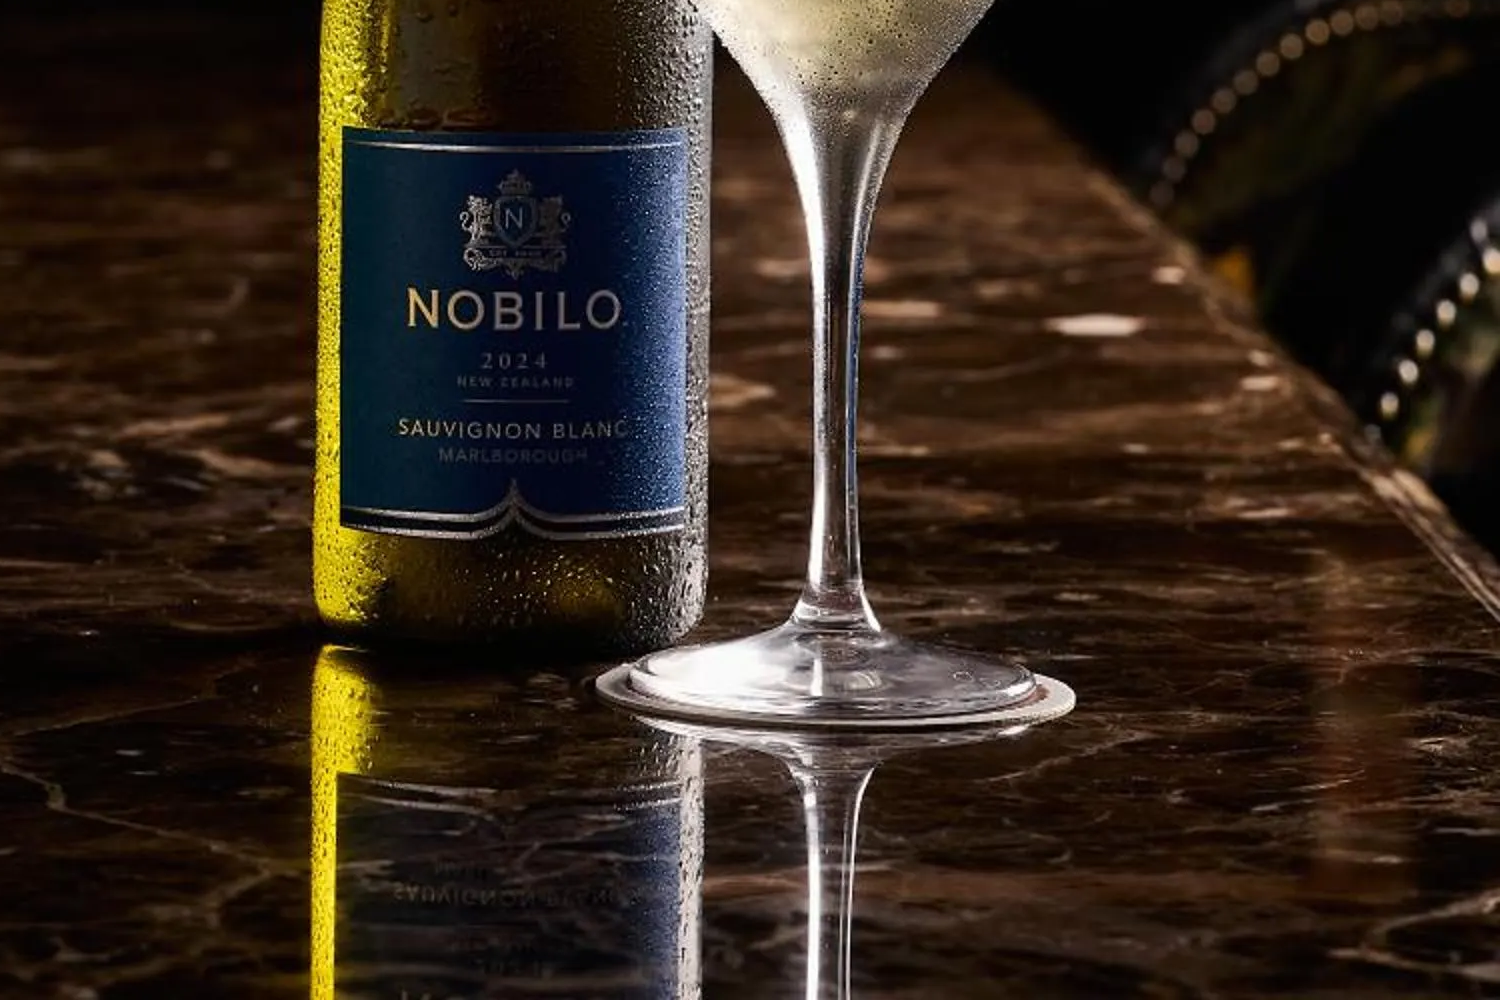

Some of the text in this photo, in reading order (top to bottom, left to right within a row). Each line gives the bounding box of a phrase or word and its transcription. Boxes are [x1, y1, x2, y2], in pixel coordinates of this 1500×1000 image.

[504, 206, 523, 230] N
[406, 285, 623, 332] NOBILO
[479, 351, 549, 370] 2024
[457, 374, 575, 389] NEW ZEALAND
[398, 416, 630, 440] SAUVIGNON BLANC
[438, 447, 589, 465] MARLBOROUGH
